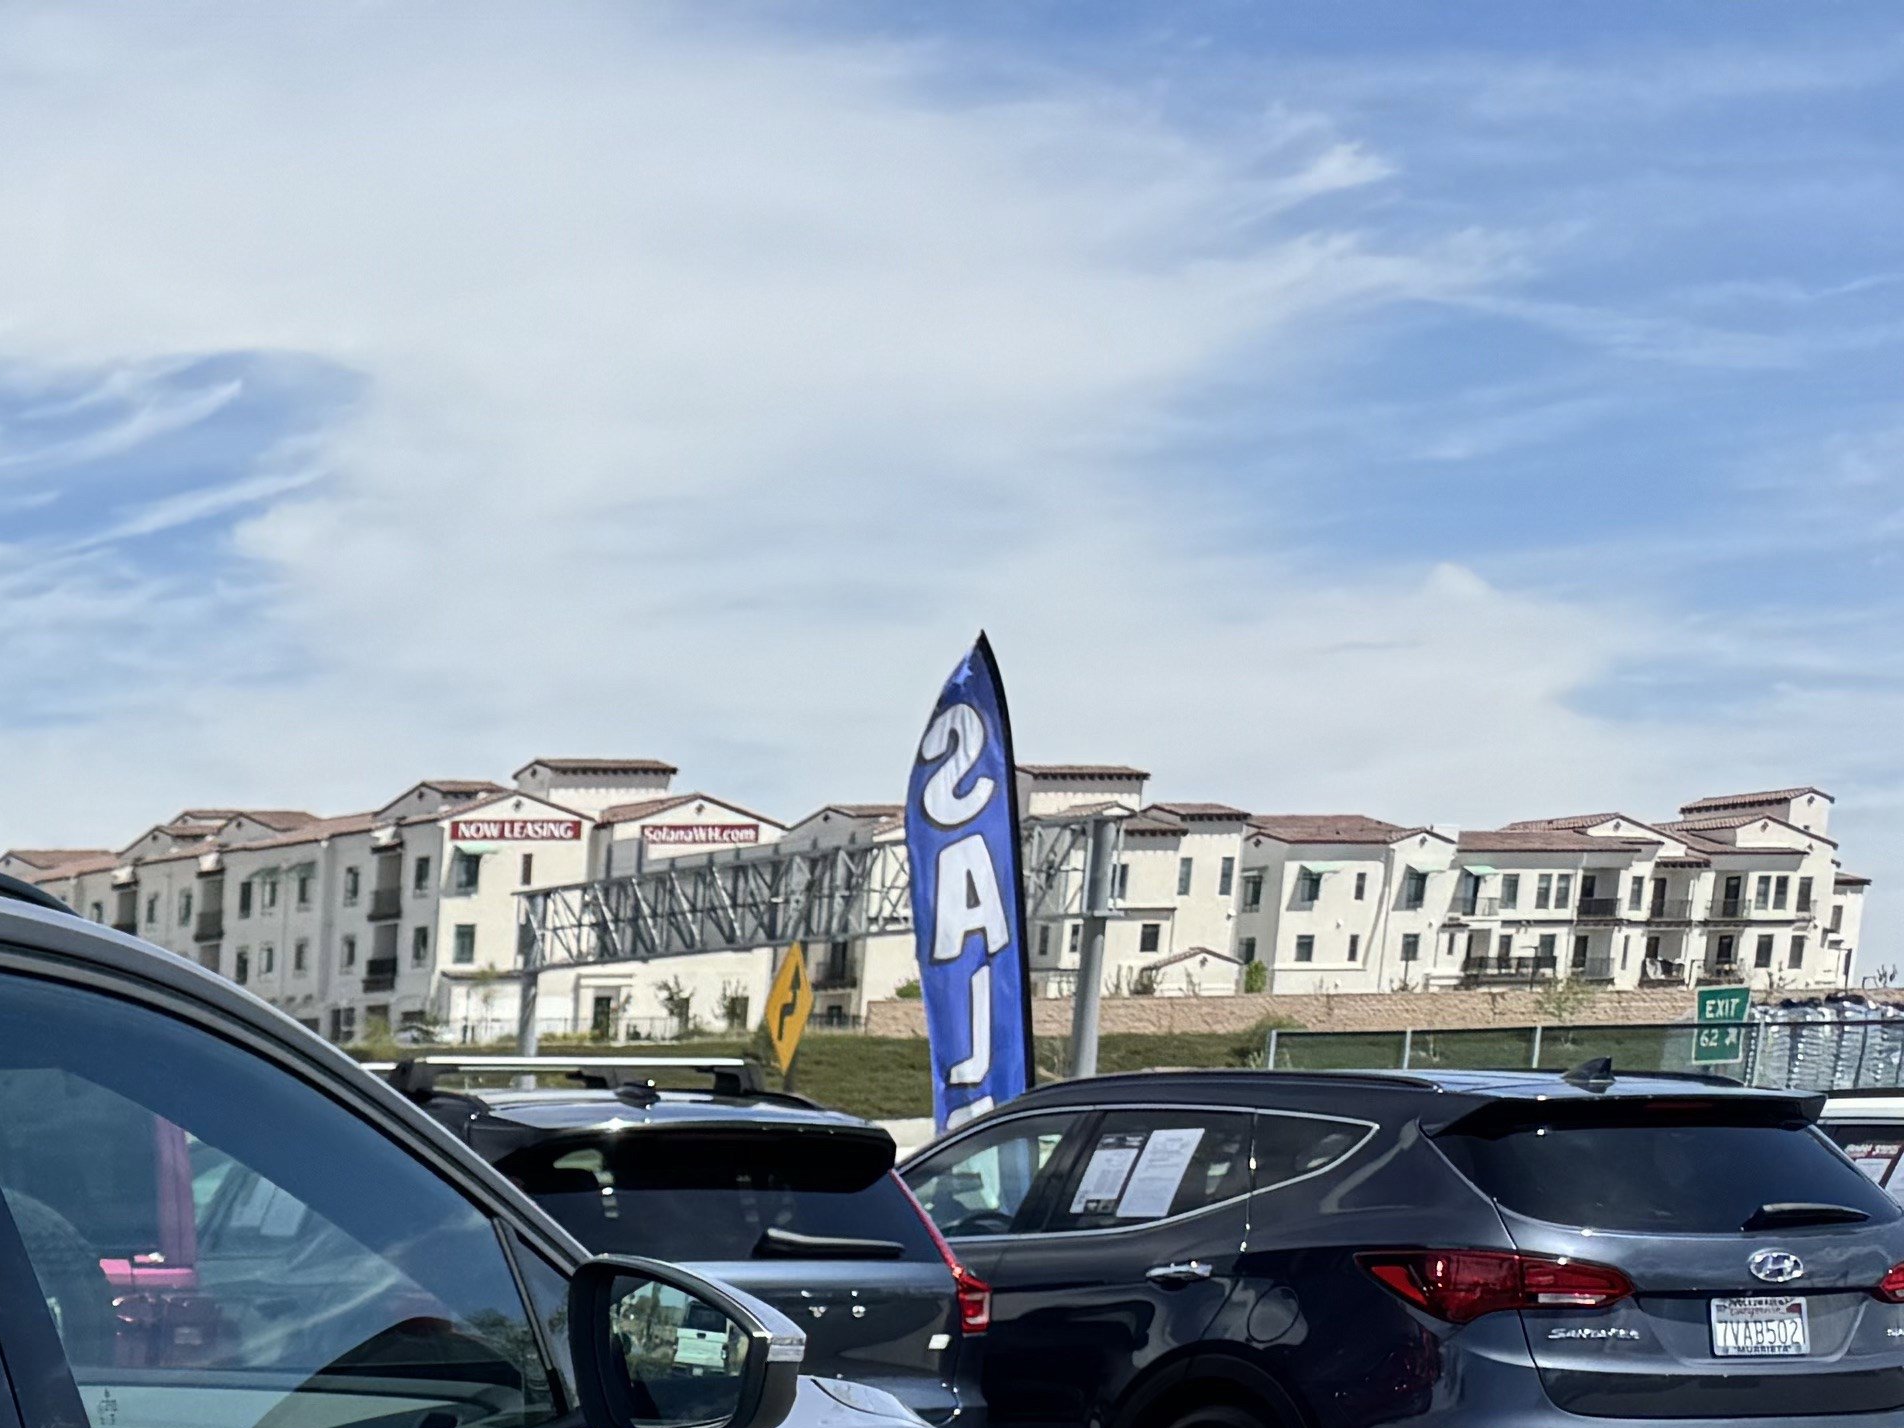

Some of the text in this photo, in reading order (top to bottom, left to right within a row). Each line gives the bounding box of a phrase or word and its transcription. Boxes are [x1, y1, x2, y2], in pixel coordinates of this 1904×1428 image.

[457, 821, 574, 840] NOW LEASING
[643, 826, 756, 843] SolanaWH.com
[1705, 998, 1740, 1018] EXIT
[1699, 1028, 1719, 1047] 62
[1717, 1319, 1799, 1347] 7VAB502
